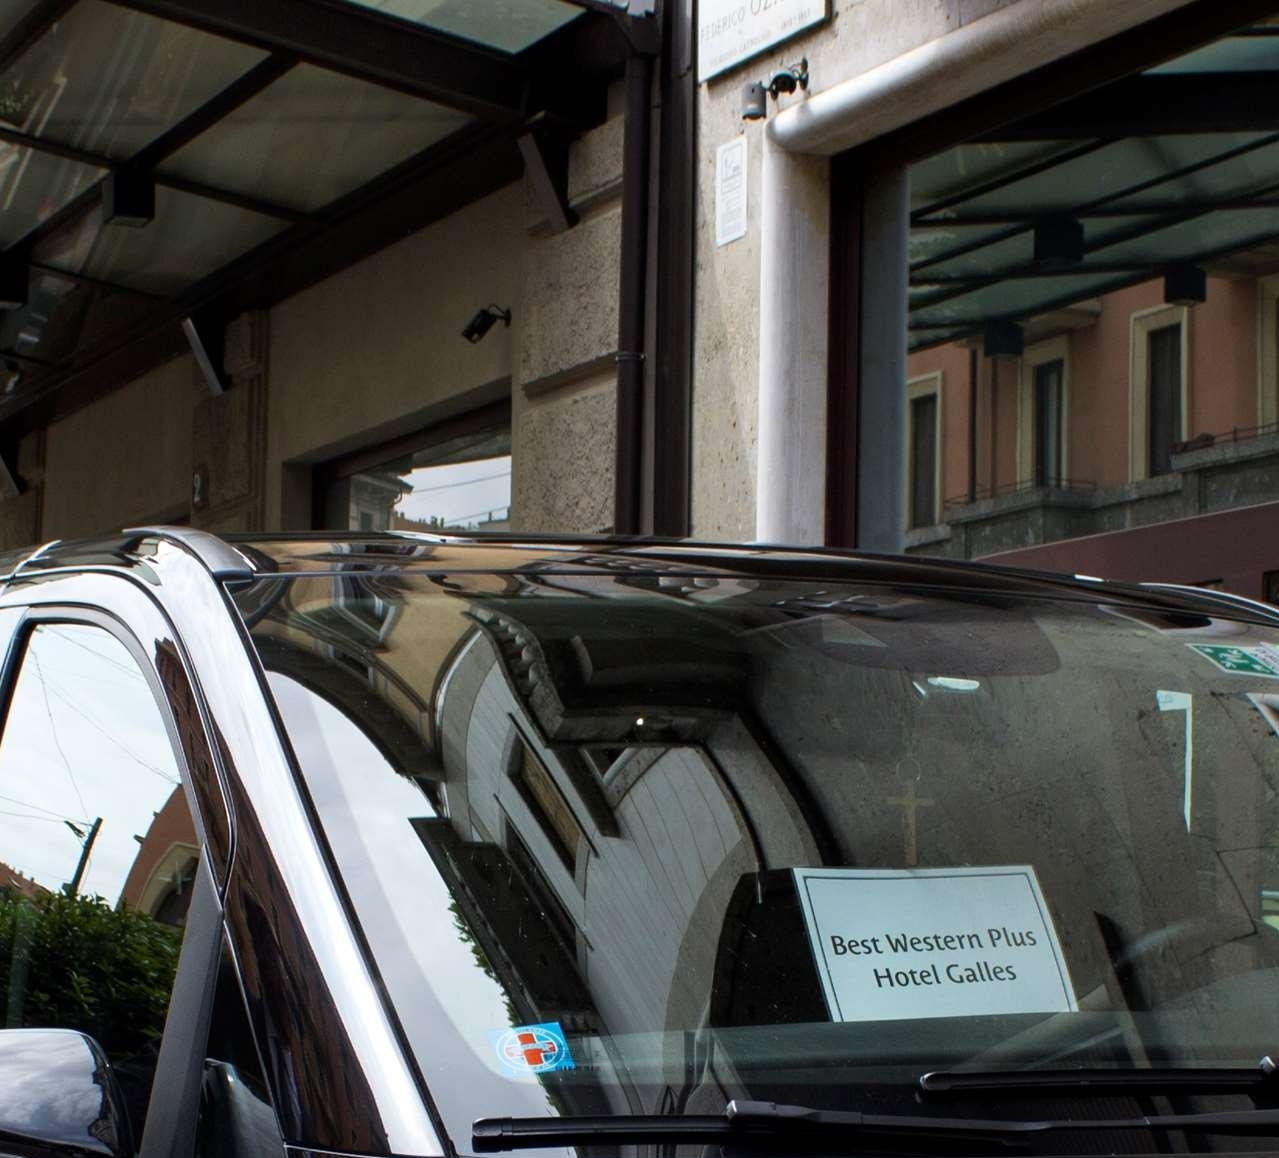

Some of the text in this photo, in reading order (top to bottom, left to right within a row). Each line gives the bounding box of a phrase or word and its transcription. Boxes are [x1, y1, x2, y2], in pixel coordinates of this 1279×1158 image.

[831, 927, 1037, 956] Best Western Plus
[873, 962, 1017, 988] Hotel Galles
